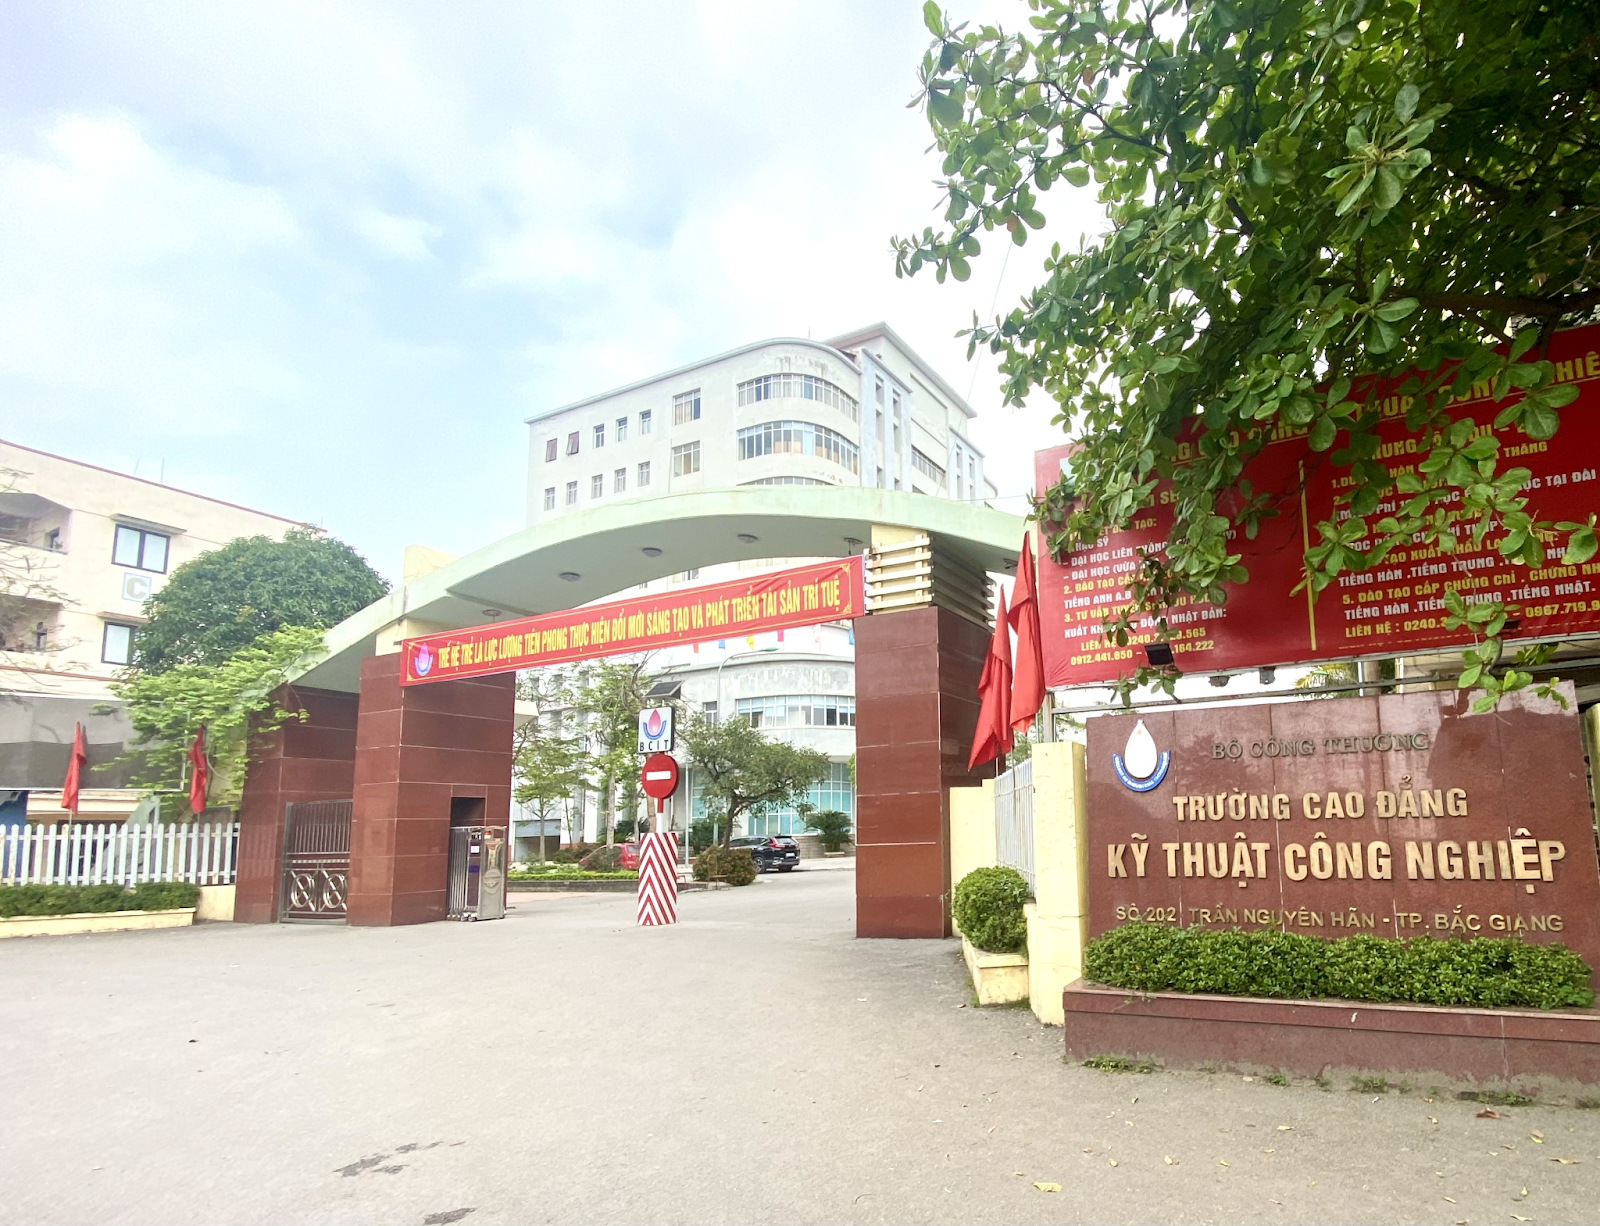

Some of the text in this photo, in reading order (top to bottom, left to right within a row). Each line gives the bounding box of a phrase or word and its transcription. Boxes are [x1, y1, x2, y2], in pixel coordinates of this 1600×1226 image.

[1545, 473, 1567, 488] TẠI
[1572, 468, 1597, 483] ĐÀI
[1135, 517, 1158, 531] TẠO:
[1071, 555, 1088, 567] ĐẠI
[1090, 551, 1109, 564] HỌC
[1112, 546, 1133, 560] LIÊN
[1072, 569, 1088, 581] ĐẠI
[1091, 565, 1110, 578] HỌC
[1338, 571, 1374, 588] TIẾNG
[1377, 568, 1403, 583] HÀN
[1451, 556, 1495, 572] TRUNG
[1387, 586, 1411, 600] TẠO
[1414, 580, 1440, 596] CẤP
[1529, 565, 1577, 582] CHỨNG
[126, 577, 148, 599] C
[1075, 580, 1094, 593] ĐÀO
[1097, 577, 1115, 590] TẠO
[1064, 595, 1090, 609] TIẾNG
[1093, 592, 1112, 605] ANH
[1344, 604, 1380, 620] TIẾNG
[1383, 602, 1410, 616] HÀN
[438, 576, 841, 671] THẾ HỆ TRẺ LÀ LỰC LƯỢNG TIÊN PHONG THỰC HIỆN ĐỔI MỚI SÁNG TẠO VÀ PHÁT TRIỂN TÀI SẢN TRÍ TUỆ
[1064, 624, 1088, 639] XUẤT
[1171, 610, 1198, 624] NHẬT
[1076, 609, 1088, 621] TƯ
[1345, 624, 1372, 638] LIÊN
[1376, 620, 1392, 636] HỆ
[1211, 739, 1244, 763] BỘ
[1250, 736, 1316, 758] CÔNG
[1172, 774, 1469, 821] TRƯỜNG CAO ĐẲNG
[1107, 827, 1567, 895] KỸ THUẬT CÔNG NGHIỆP
[1146, 906, 1177, 922] 202
[1243, 906, 1324, 927] NGUYÊN
[1330, 906, 1375, 928] HÃN
[1434, 904, 1482, 931] BẮC
[1488, 913, 1564, 932] GIANG
